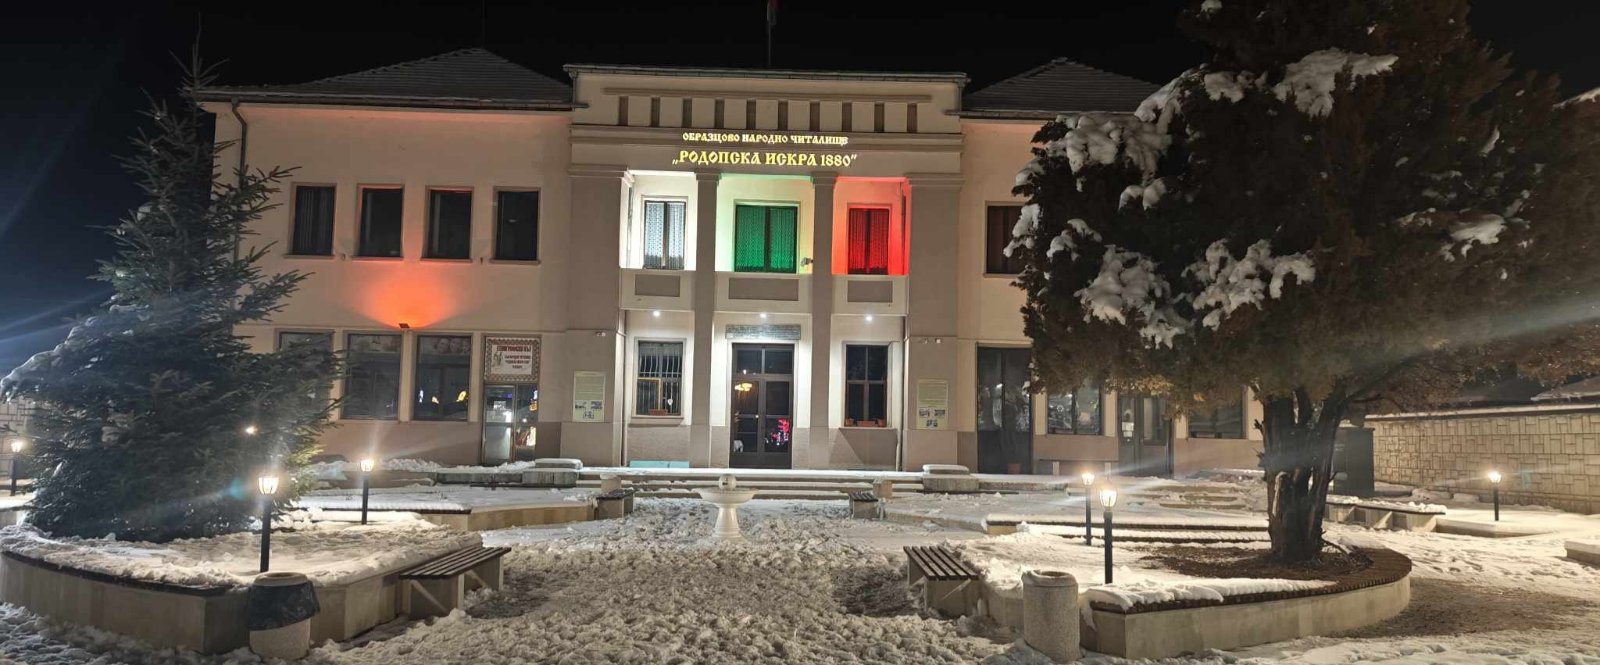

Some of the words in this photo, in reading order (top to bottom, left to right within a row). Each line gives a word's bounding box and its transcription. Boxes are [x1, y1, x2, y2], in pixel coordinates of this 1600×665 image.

[682, 132, 740, 143] ОБРАЗЦОВО
[742, 134, 788, 144] НАРОДНО
[765, 152, 817, 166] ИСКРА
